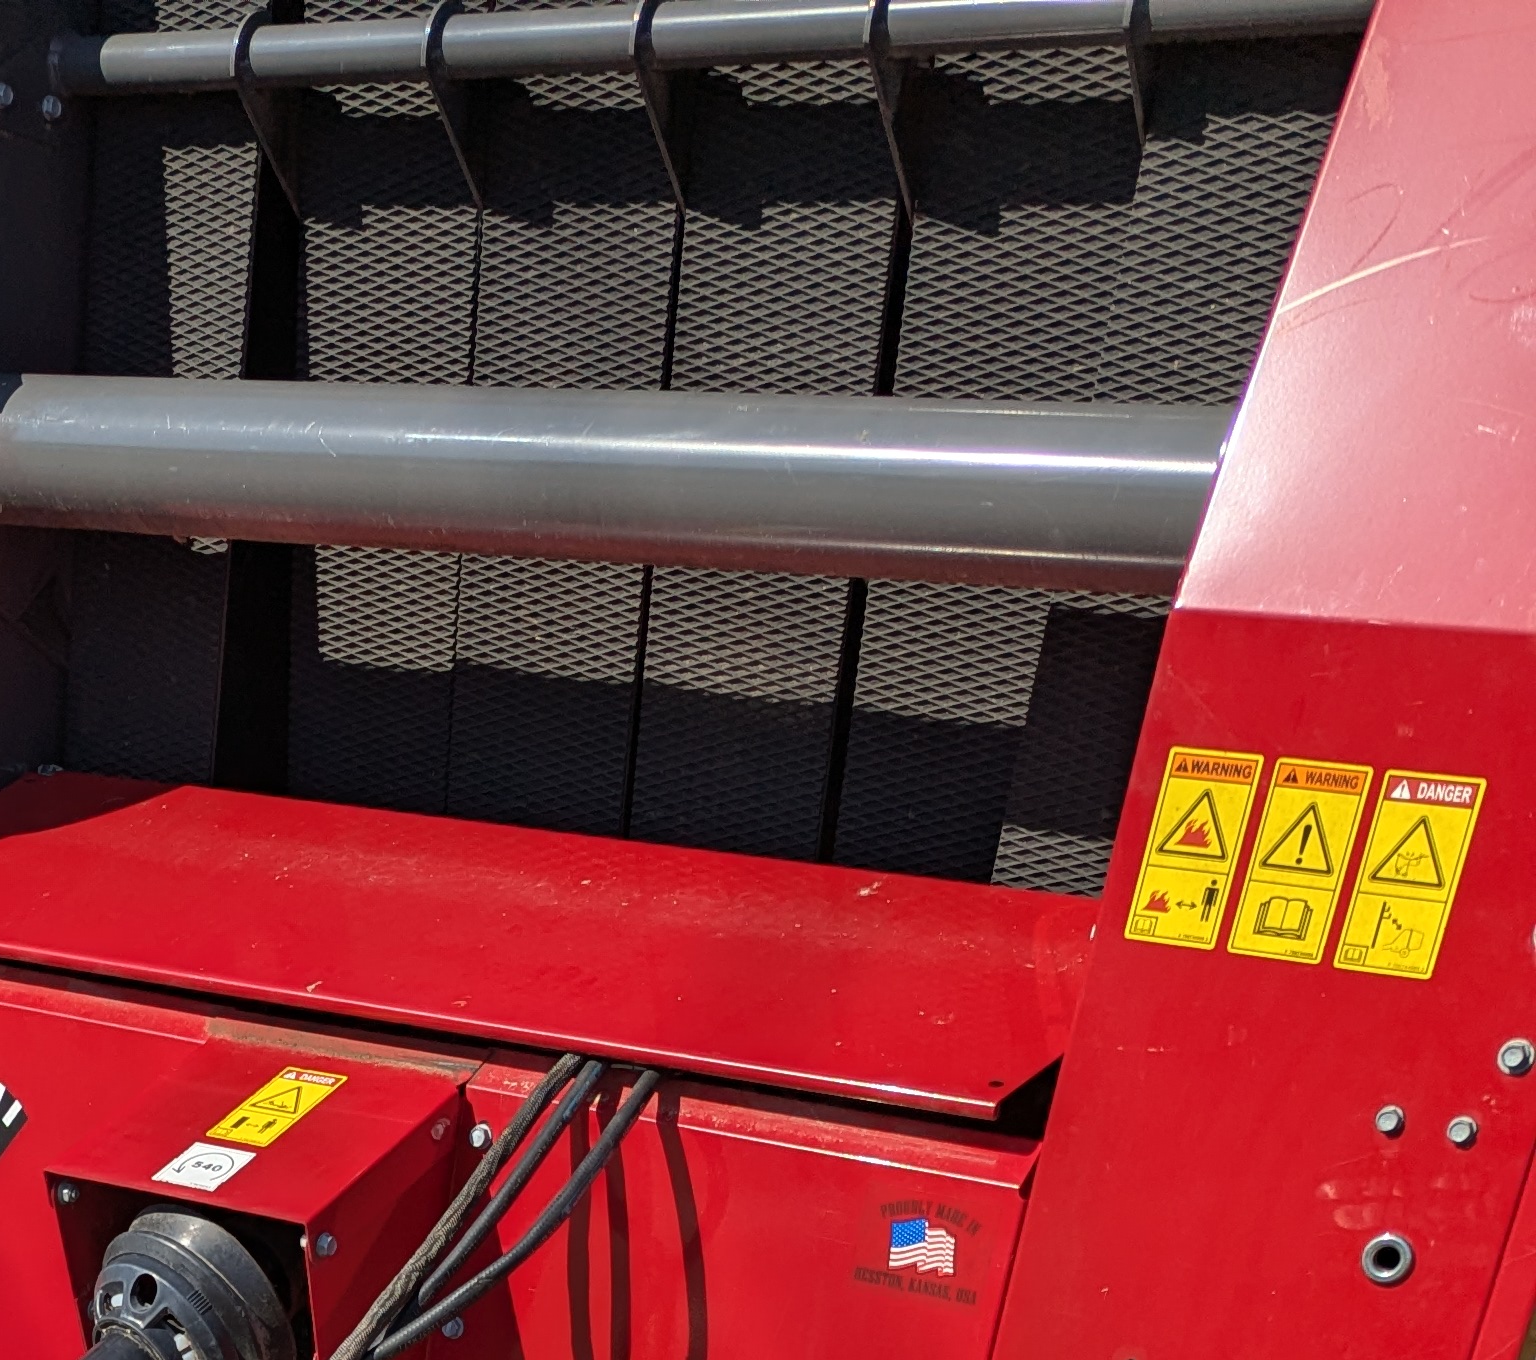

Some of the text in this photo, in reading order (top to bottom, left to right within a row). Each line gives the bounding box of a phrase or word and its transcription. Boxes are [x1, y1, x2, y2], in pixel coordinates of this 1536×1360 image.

[1190, 758, 1253, 780] WARNING
[1304, 770, 1360, 791] WARNING
[1416, 781, 1473, 805] DANGER
[298, 1072, 336, 1086] DANGER
[191, 1161, 223, 1173] 540
[880, 1200, 982, 1237] PROUDLY MADE IN
[853, 1266, 977, 1306] HESSTON, KANSAS, USA
